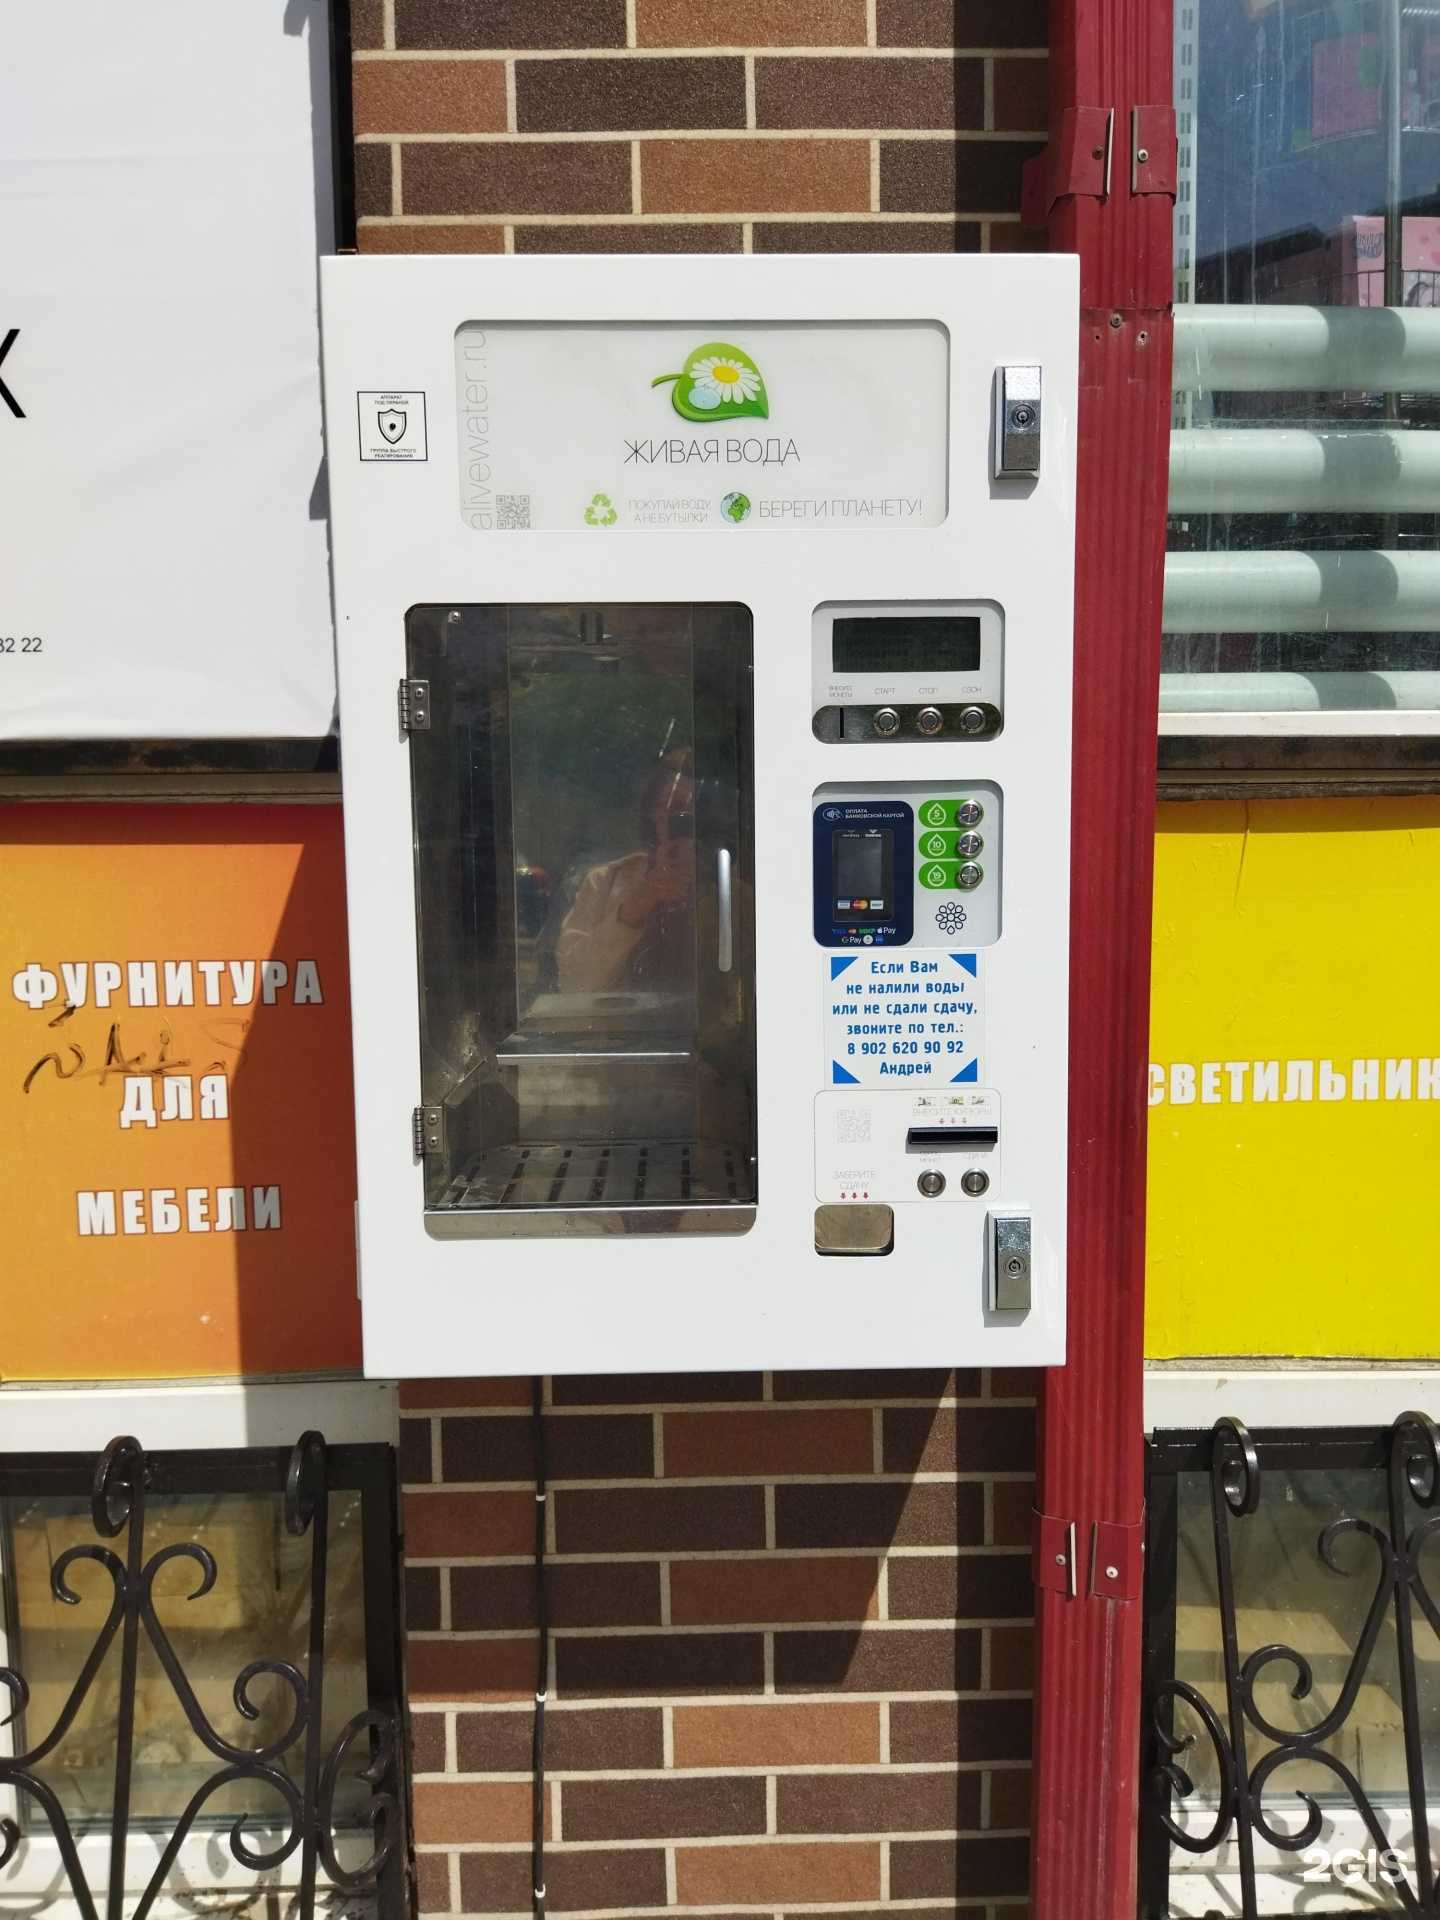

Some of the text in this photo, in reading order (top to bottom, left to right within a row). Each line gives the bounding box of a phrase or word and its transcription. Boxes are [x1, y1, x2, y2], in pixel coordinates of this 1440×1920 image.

[623, 438, 801, 467] ЖИВАЯ ВОДА
[759, 499, 923, 518] БЕРЕГИ ПЛАНЕТУ!
[21, 637, 43, 653] 22
[871, 960, 938, 974] Если Вам
[12, 959, 325, 1009] ФУРНИТУРА
[846, 981, 965, 995] не налили воды
[832, 1001, 978, 1016] или не сдали сдачу,
[847, 1022, 964, 1035] звоните по тел.:
[847, 1040, 964, 1055] 8 902 620 90 92
[879, 1061, 932, 1076] Андрей
[119, 1073, 230, 1129] ДЛЯ
[76, 1184, 283, 1236] МЕБЕЛИ
